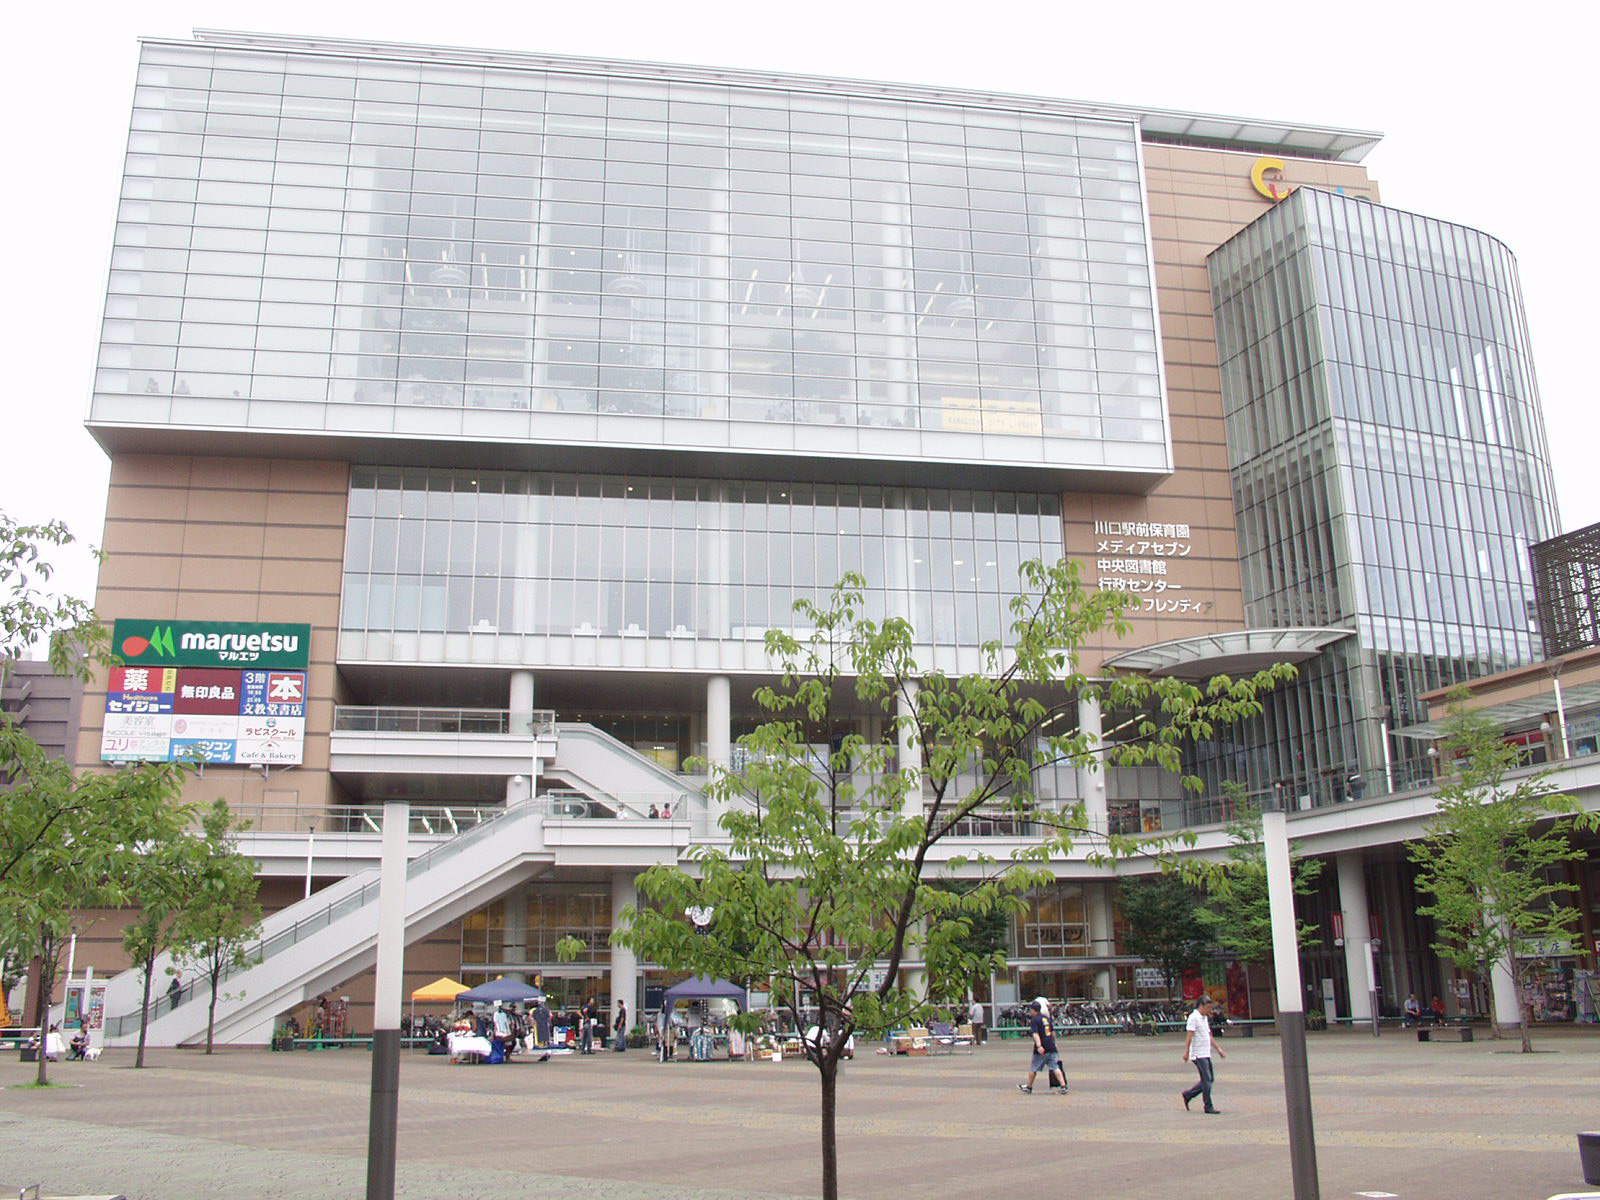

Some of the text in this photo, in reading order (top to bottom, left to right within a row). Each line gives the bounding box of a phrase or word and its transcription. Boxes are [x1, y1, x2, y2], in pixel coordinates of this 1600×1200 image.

[1094, 521, 1190, 539] 川口駅前保育園
[1096, 540, 1191, 556] メディアセブン
[1097, 558, 1167, 575] 中央図書館
[1098, 577, 1181, 593] 行政センター
[181, 632, 299, 652] maruetsu
[218, 651, 260, 661] マルエツ
[123, 669, 149, 691] 薬
[245, 672, 266, 684] 3階
[181, 685, 235, 700] 無印良品
[269, 676, 302, 701] 本
[109, 700, 171, 713] セイジョー
[243, 703, 303, 716] 文教堂書店
[269, 752, 296, 761] Bakery
[1032, 928, 1083, 941] マルエツ
